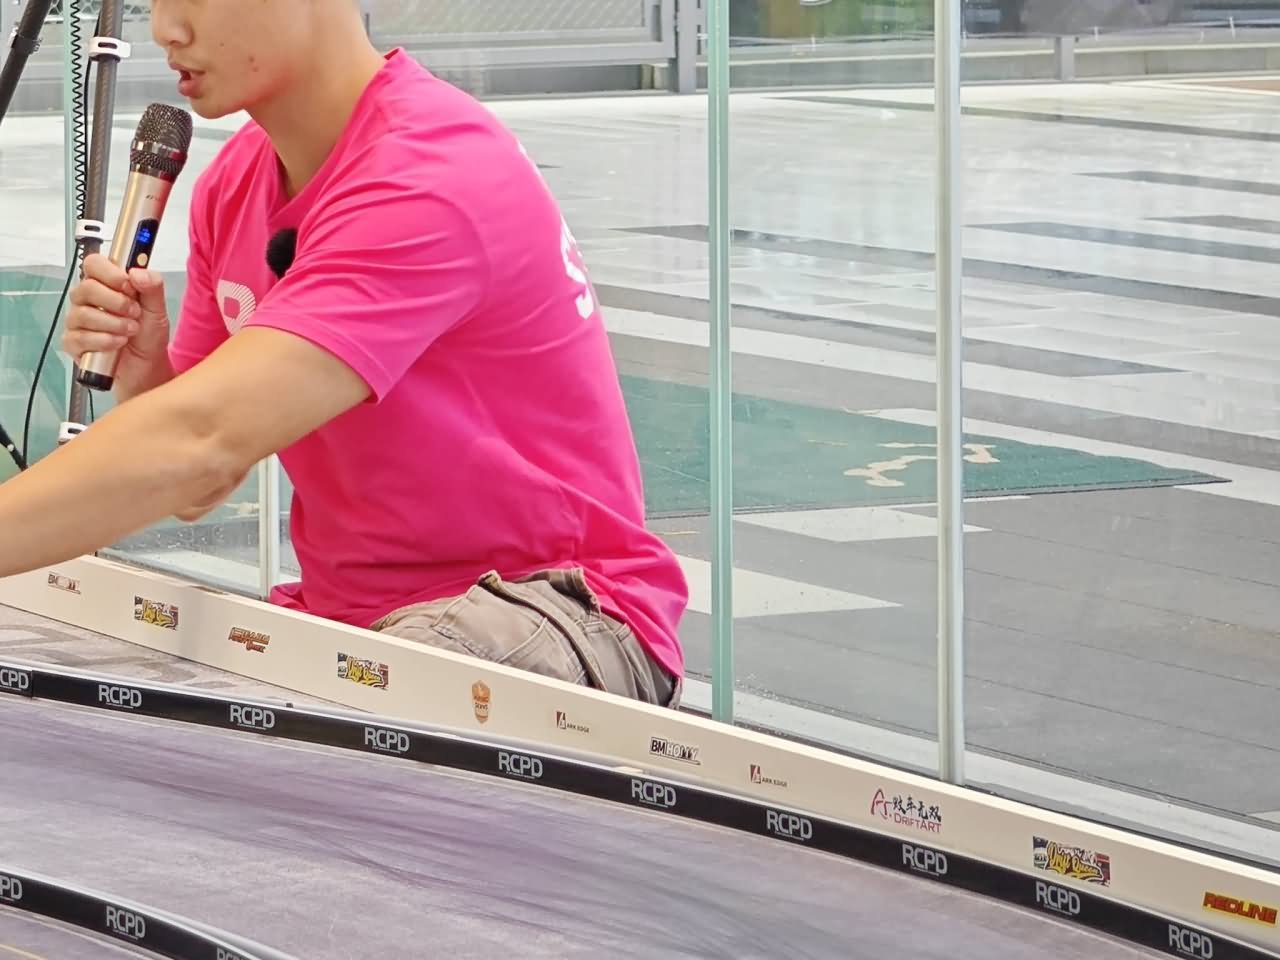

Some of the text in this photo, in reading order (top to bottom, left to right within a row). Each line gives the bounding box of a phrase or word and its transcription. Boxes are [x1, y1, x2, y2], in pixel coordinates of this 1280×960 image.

[99, 684, 142, 708] RCPD
[230, 704, 275, 729] RCPD
[364, 727, 410, 752] RCPD
[498, 752, 543, 778] RCPD
[632, 779, 677, 807] RCPD
[767, 809, 813, 839] RCPD
[902, 843, 948, 875] RCPD
[1036, 881, 1081, 915] RCPD
[1203, 891, 1278, 924] REDLINE
[106, 905, 146, 939] RCPD
[1168, 924, 1213, 959] RCPD
